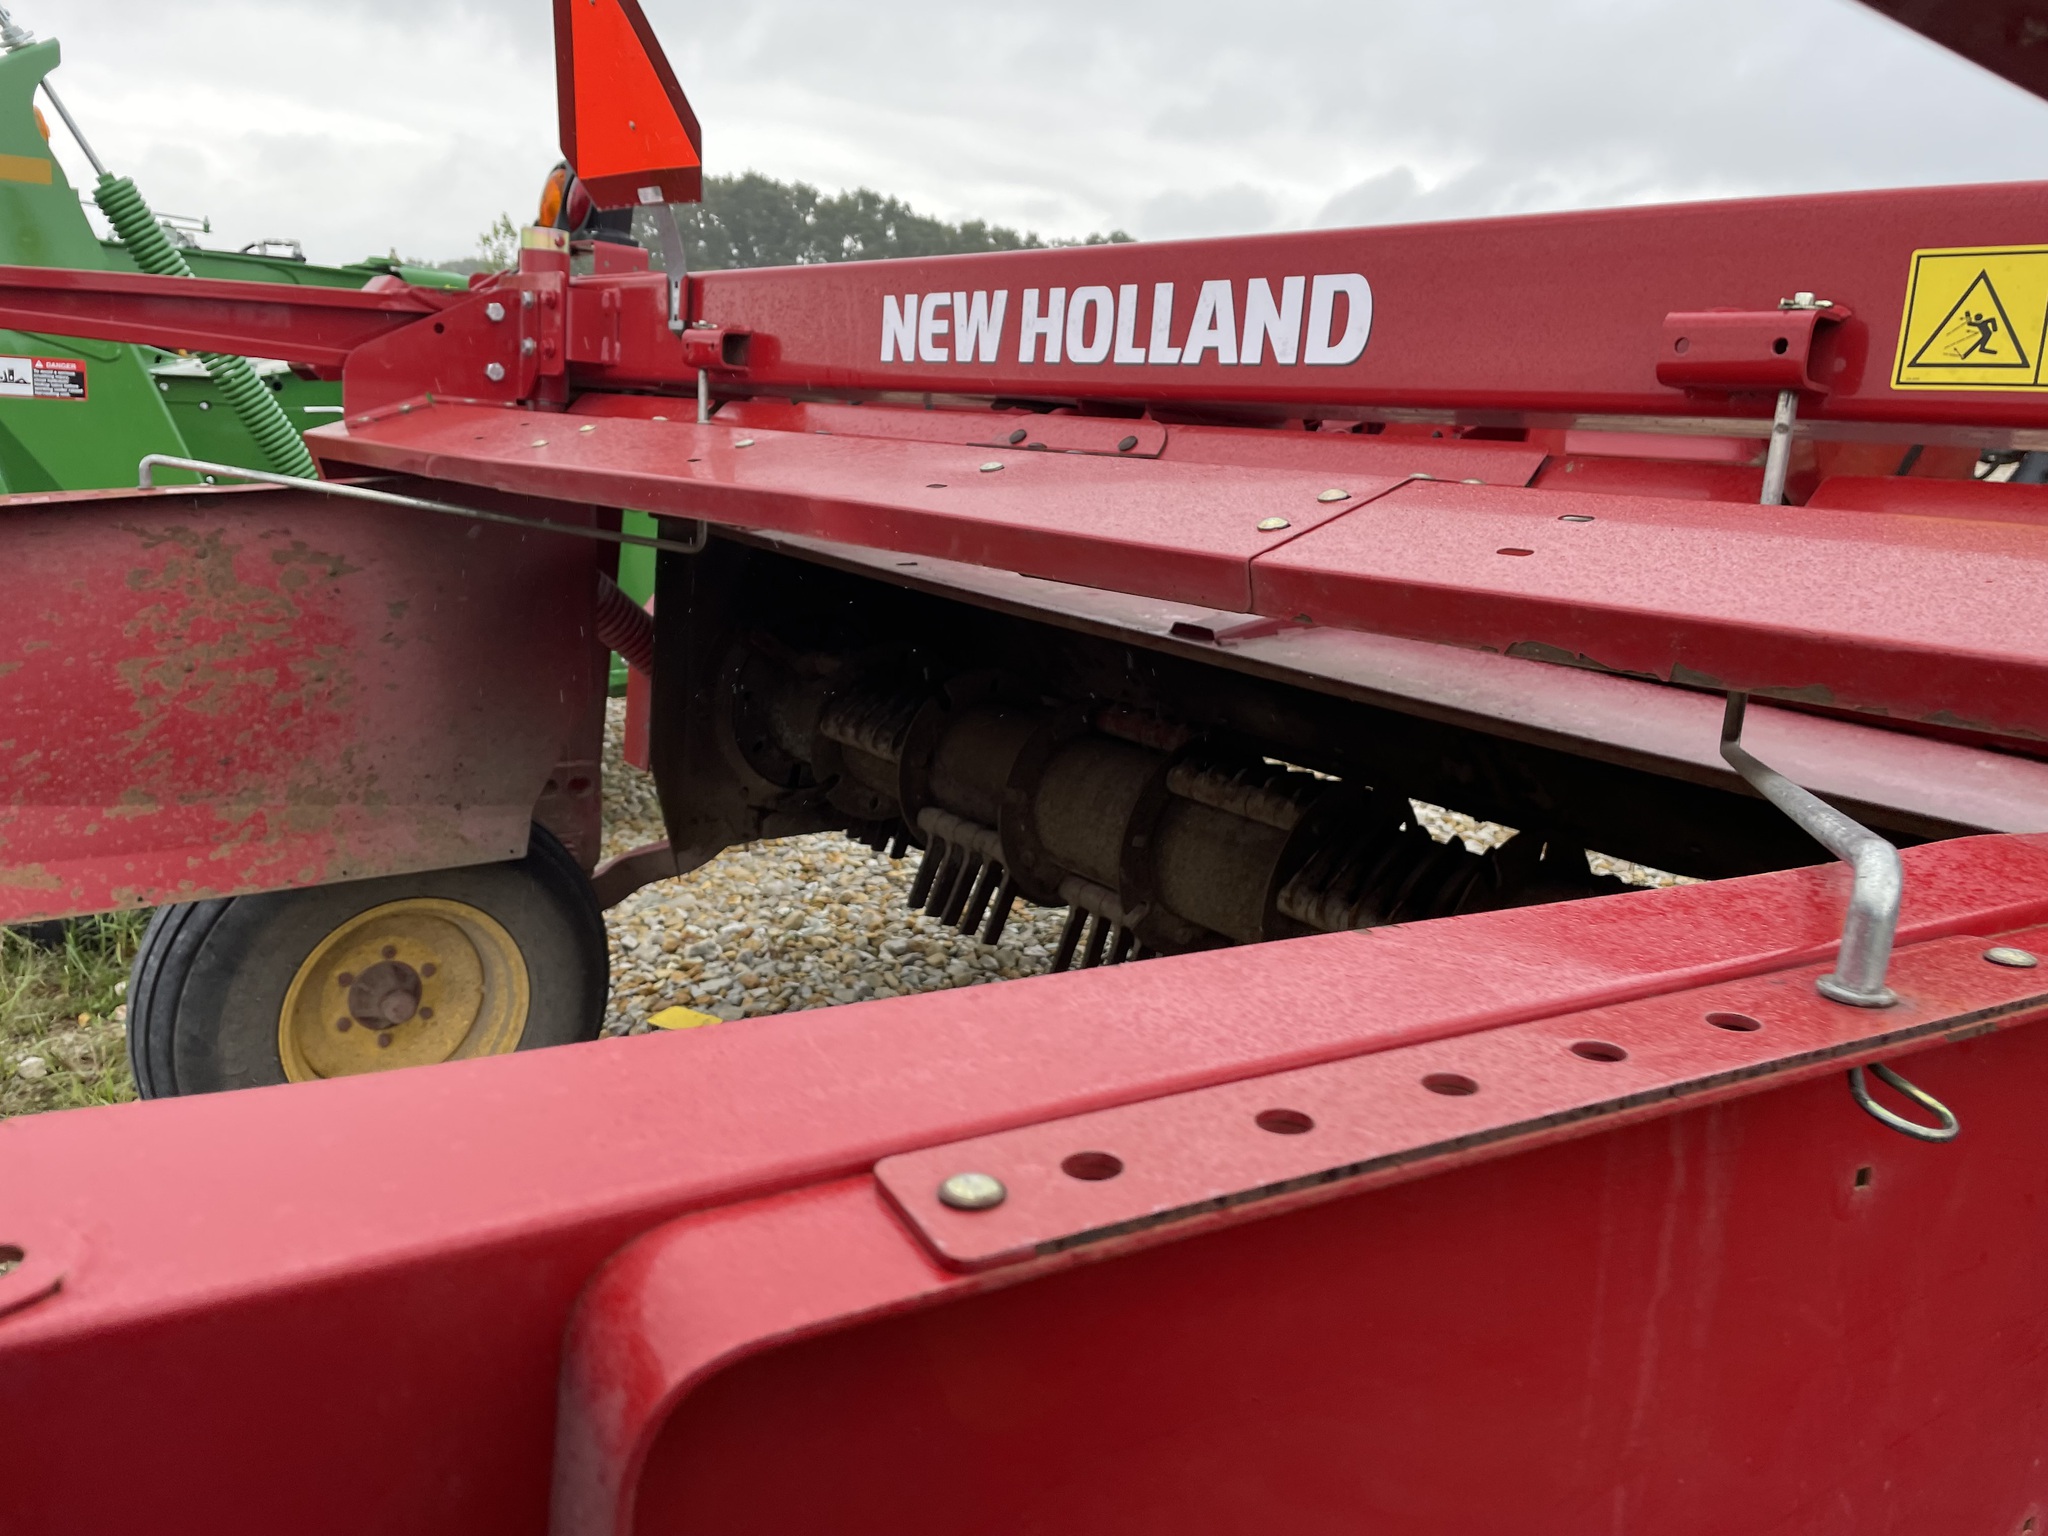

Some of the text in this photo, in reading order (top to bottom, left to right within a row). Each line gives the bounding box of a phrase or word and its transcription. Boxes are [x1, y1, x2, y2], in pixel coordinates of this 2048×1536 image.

[880, 273, 1374, 367] NEW HOLLAND
[46, 361, 77, 369] DANGER
